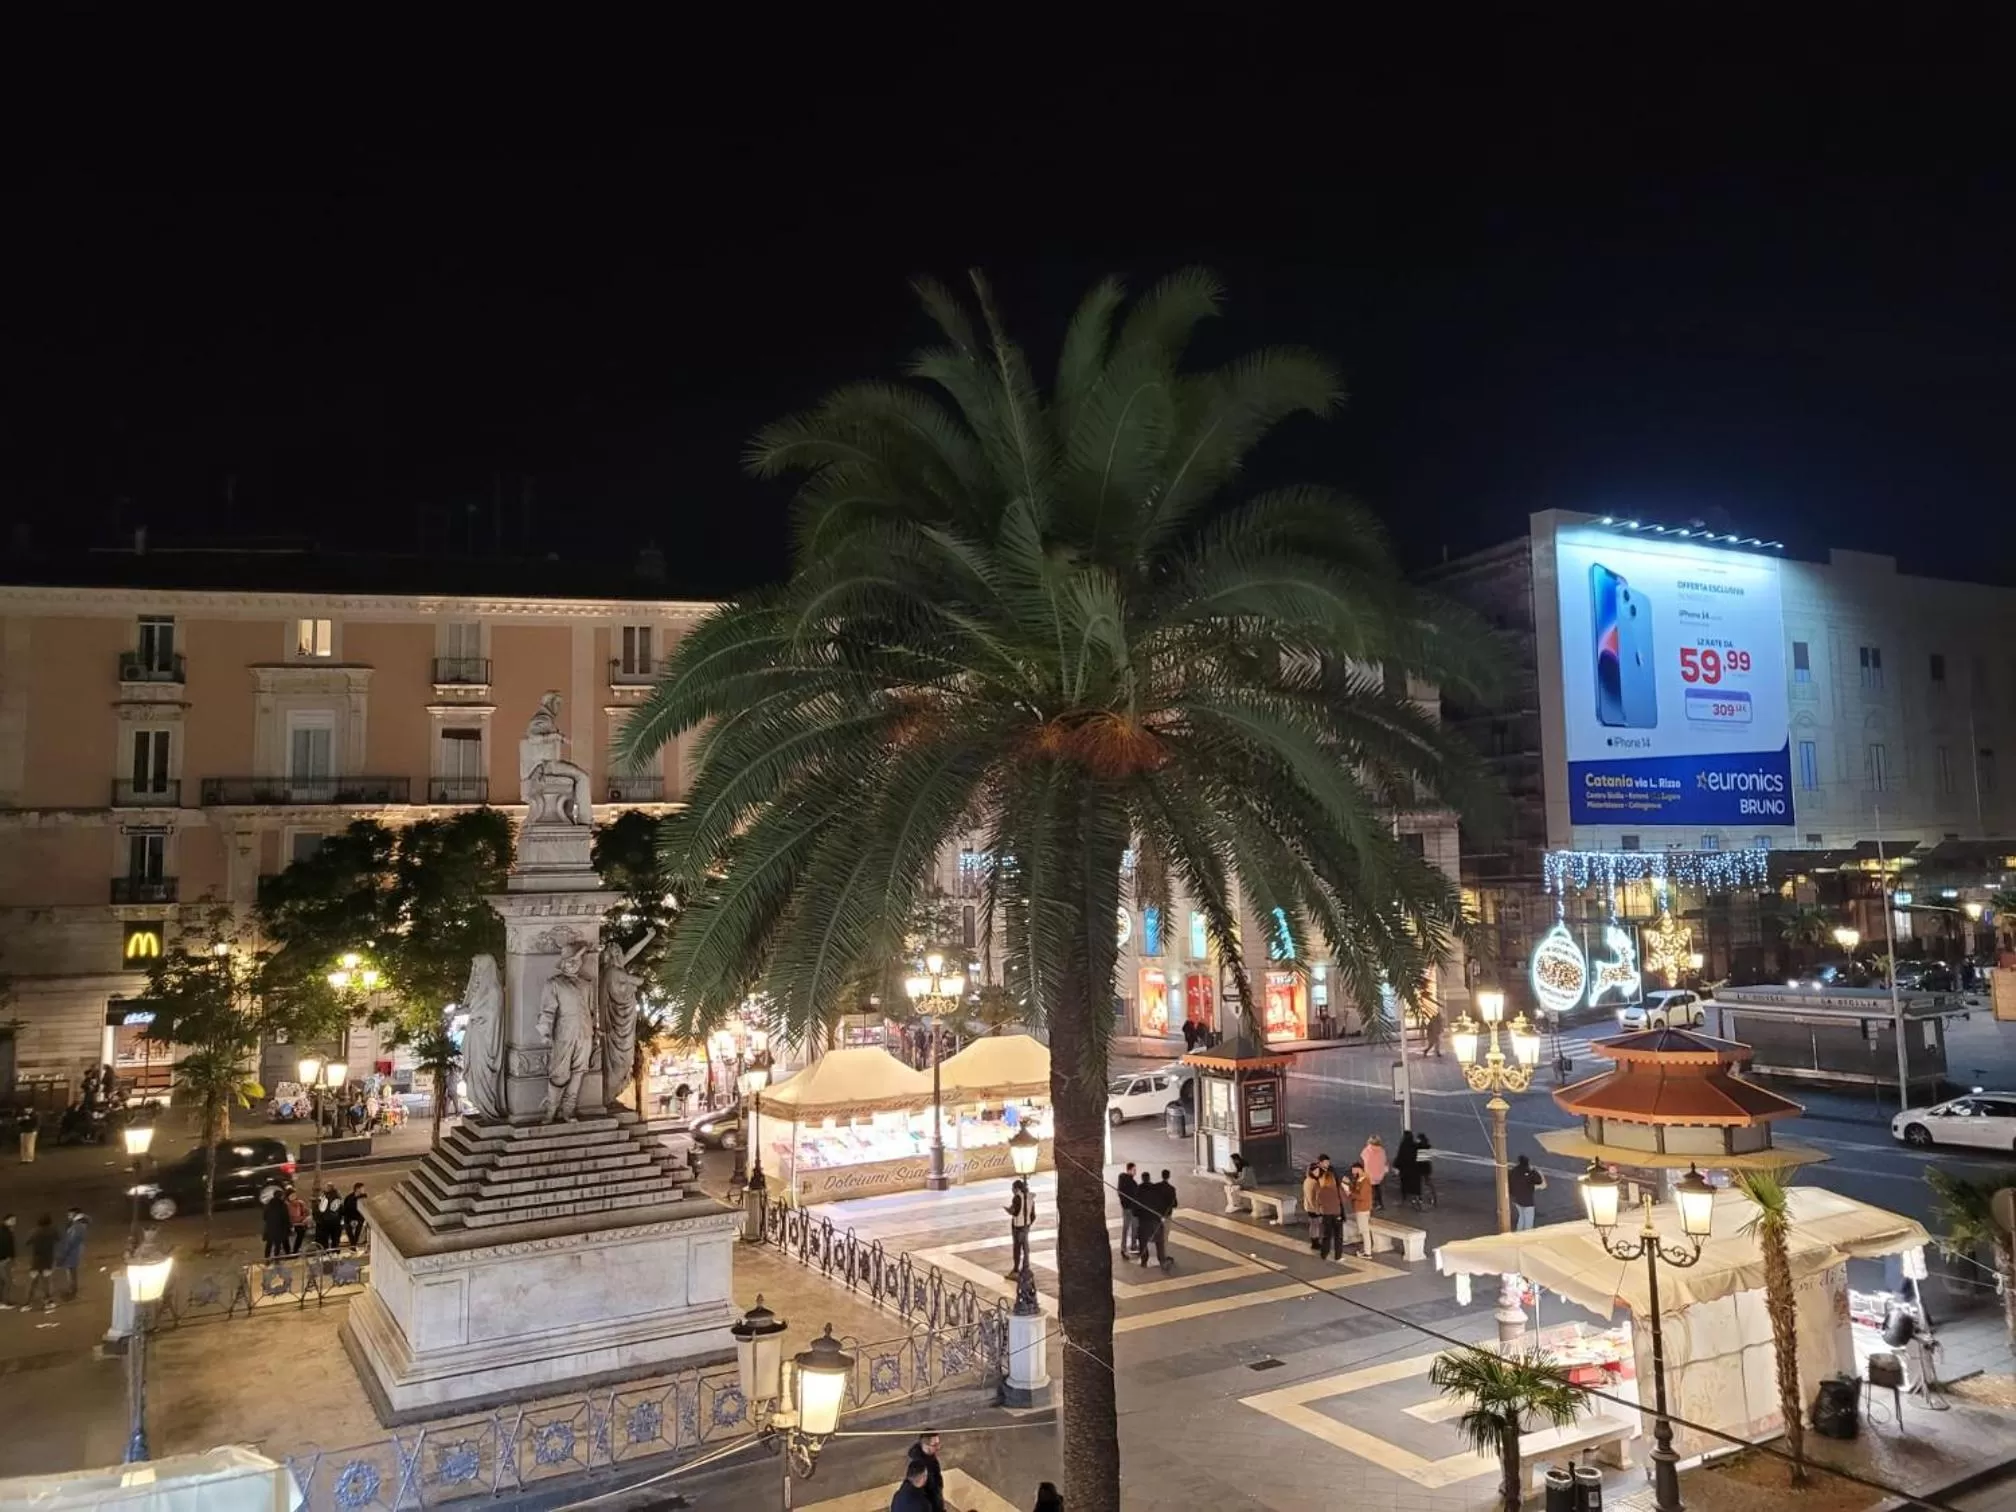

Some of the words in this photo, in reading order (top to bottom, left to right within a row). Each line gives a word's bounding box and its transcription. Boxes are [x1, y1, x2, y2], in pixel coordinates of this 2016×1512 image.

[1585, 773, 1634, 788] Catania
[1707, 767, 1784, 792] euronics
[1740, 799, 1786, 815] BRUNO
[823, 1173, 890, 1190] Dolciumi
